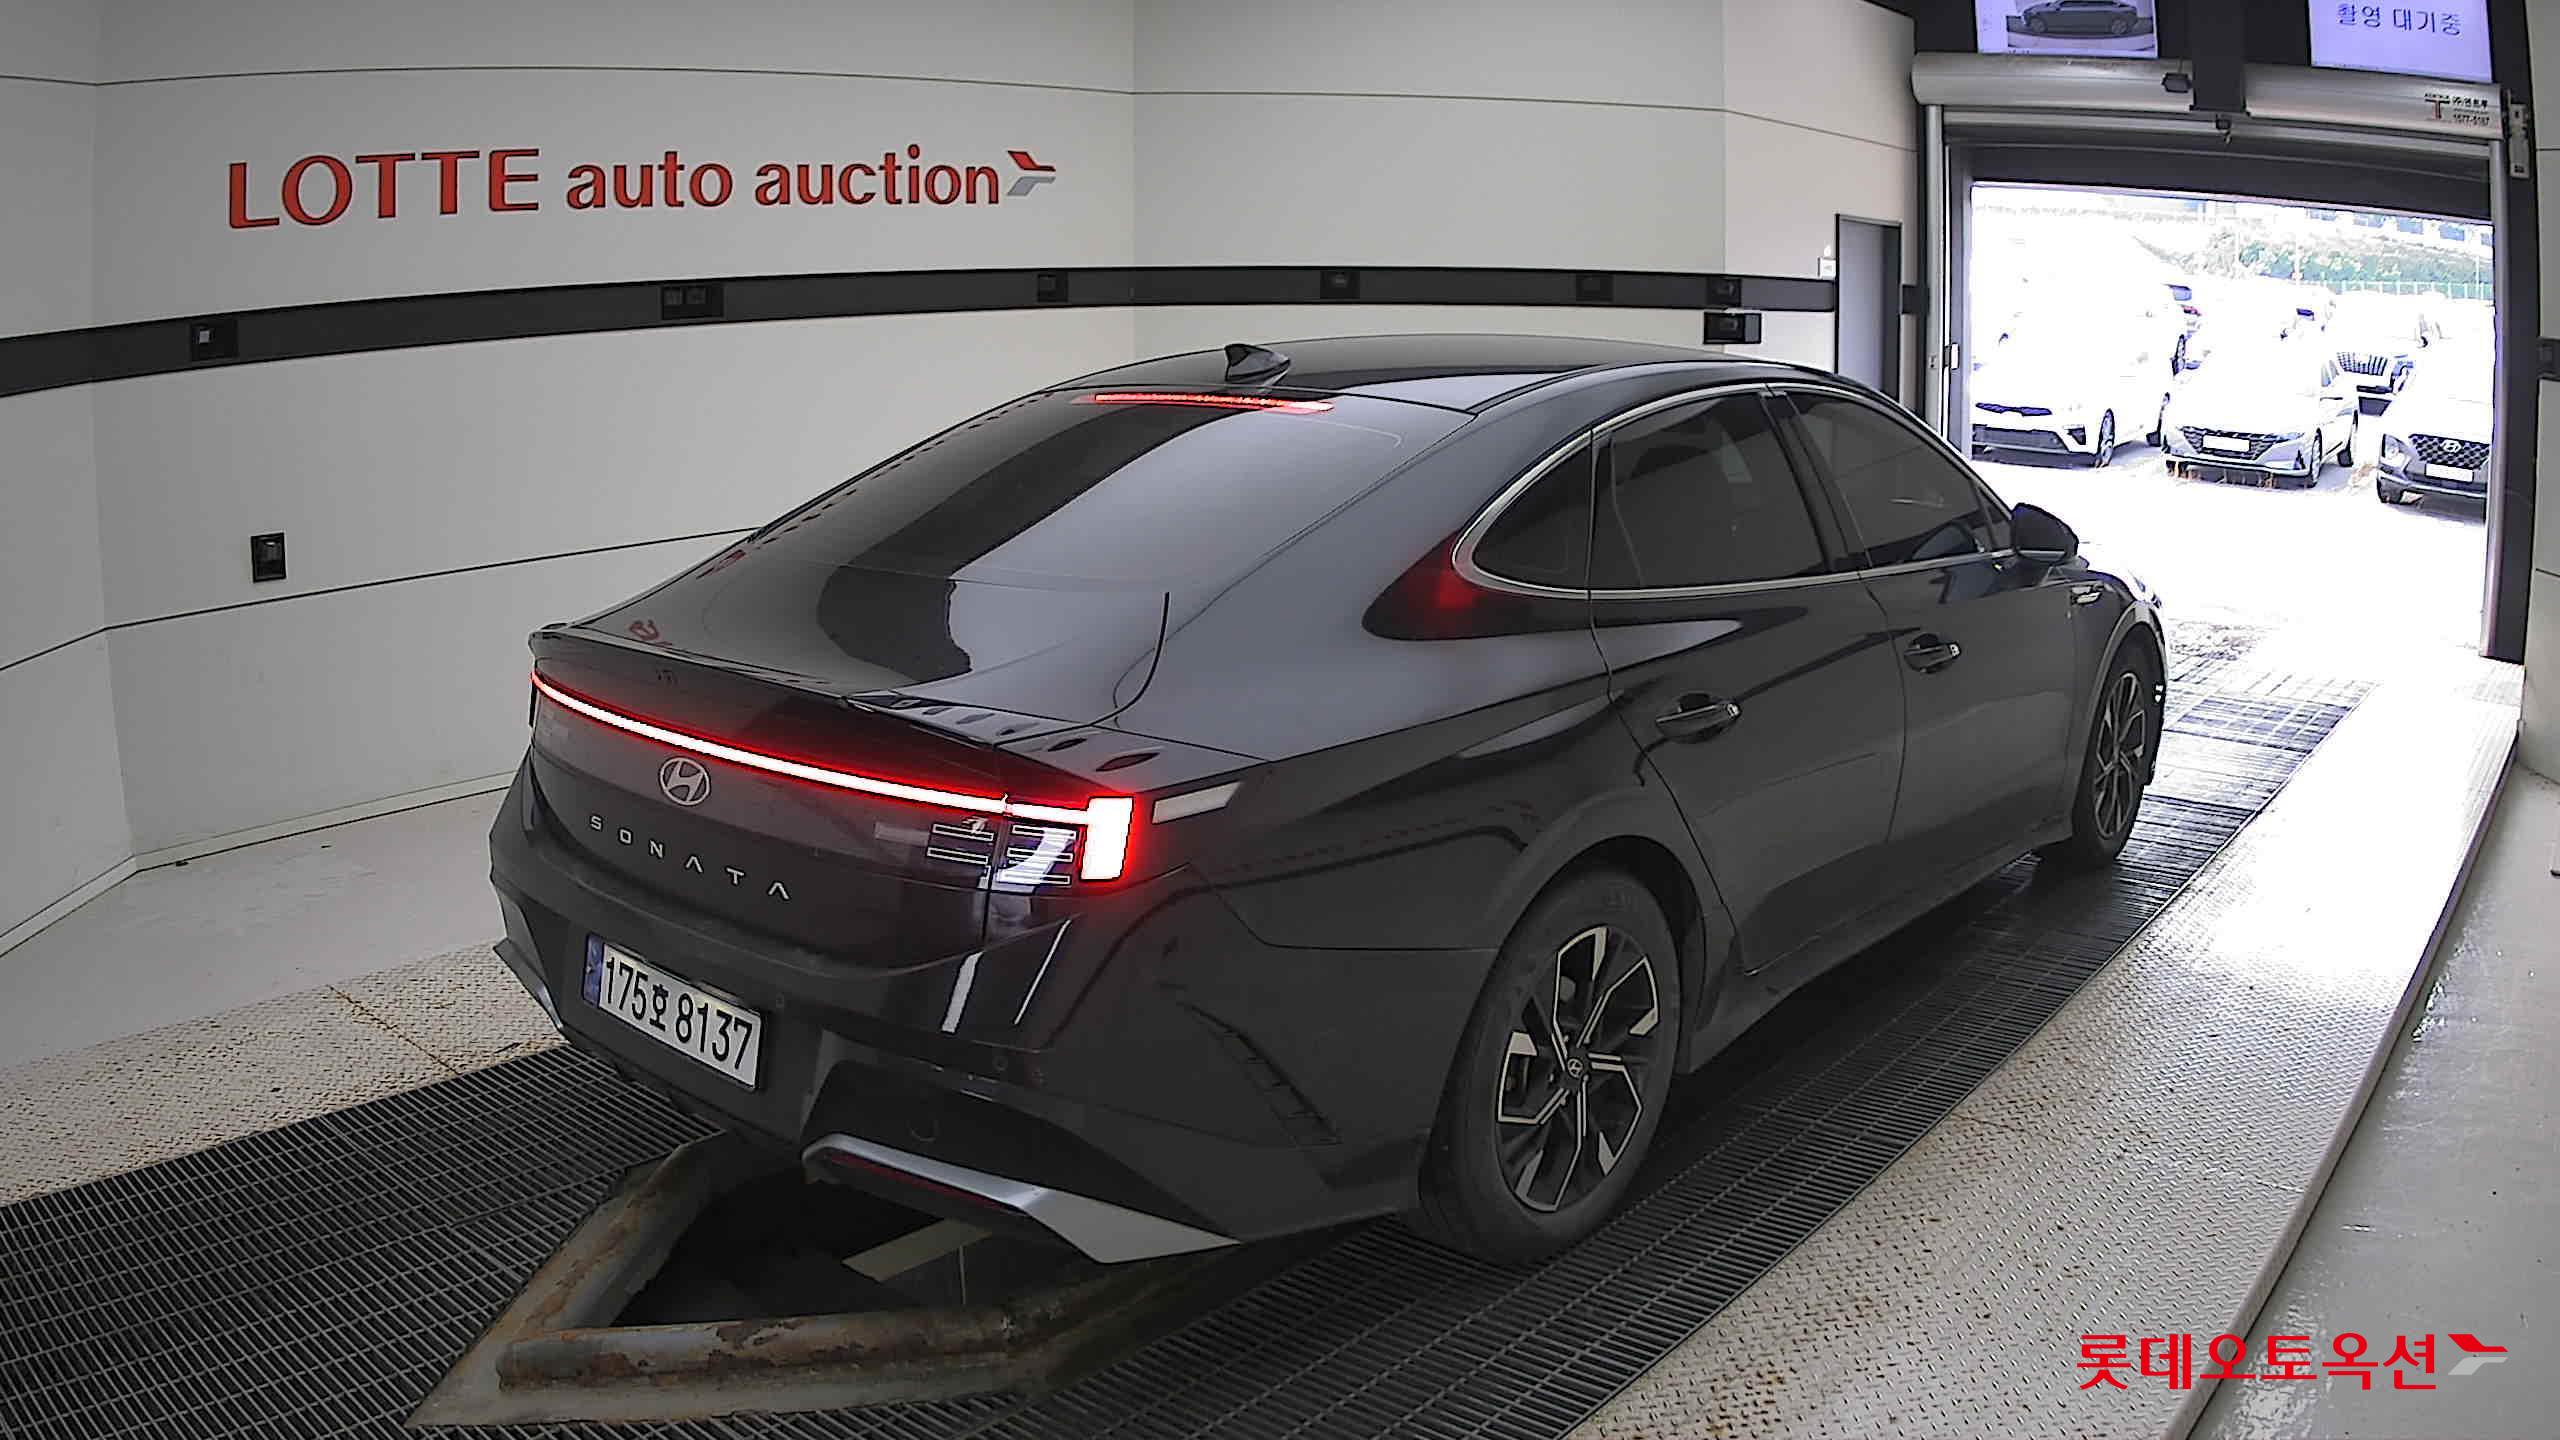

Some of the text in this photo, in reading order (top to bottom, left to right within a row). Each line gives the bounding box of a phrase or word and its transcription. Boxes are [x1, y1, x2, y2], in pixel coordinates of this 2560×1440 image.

[2338, 3, 2461, 36] 촬영 대기중
[229, 143, 1000, 229] LOTTE auto auction
[590, 815, 790, 900] SONATA
[606, 956, 753, 1070] 175호 8137
